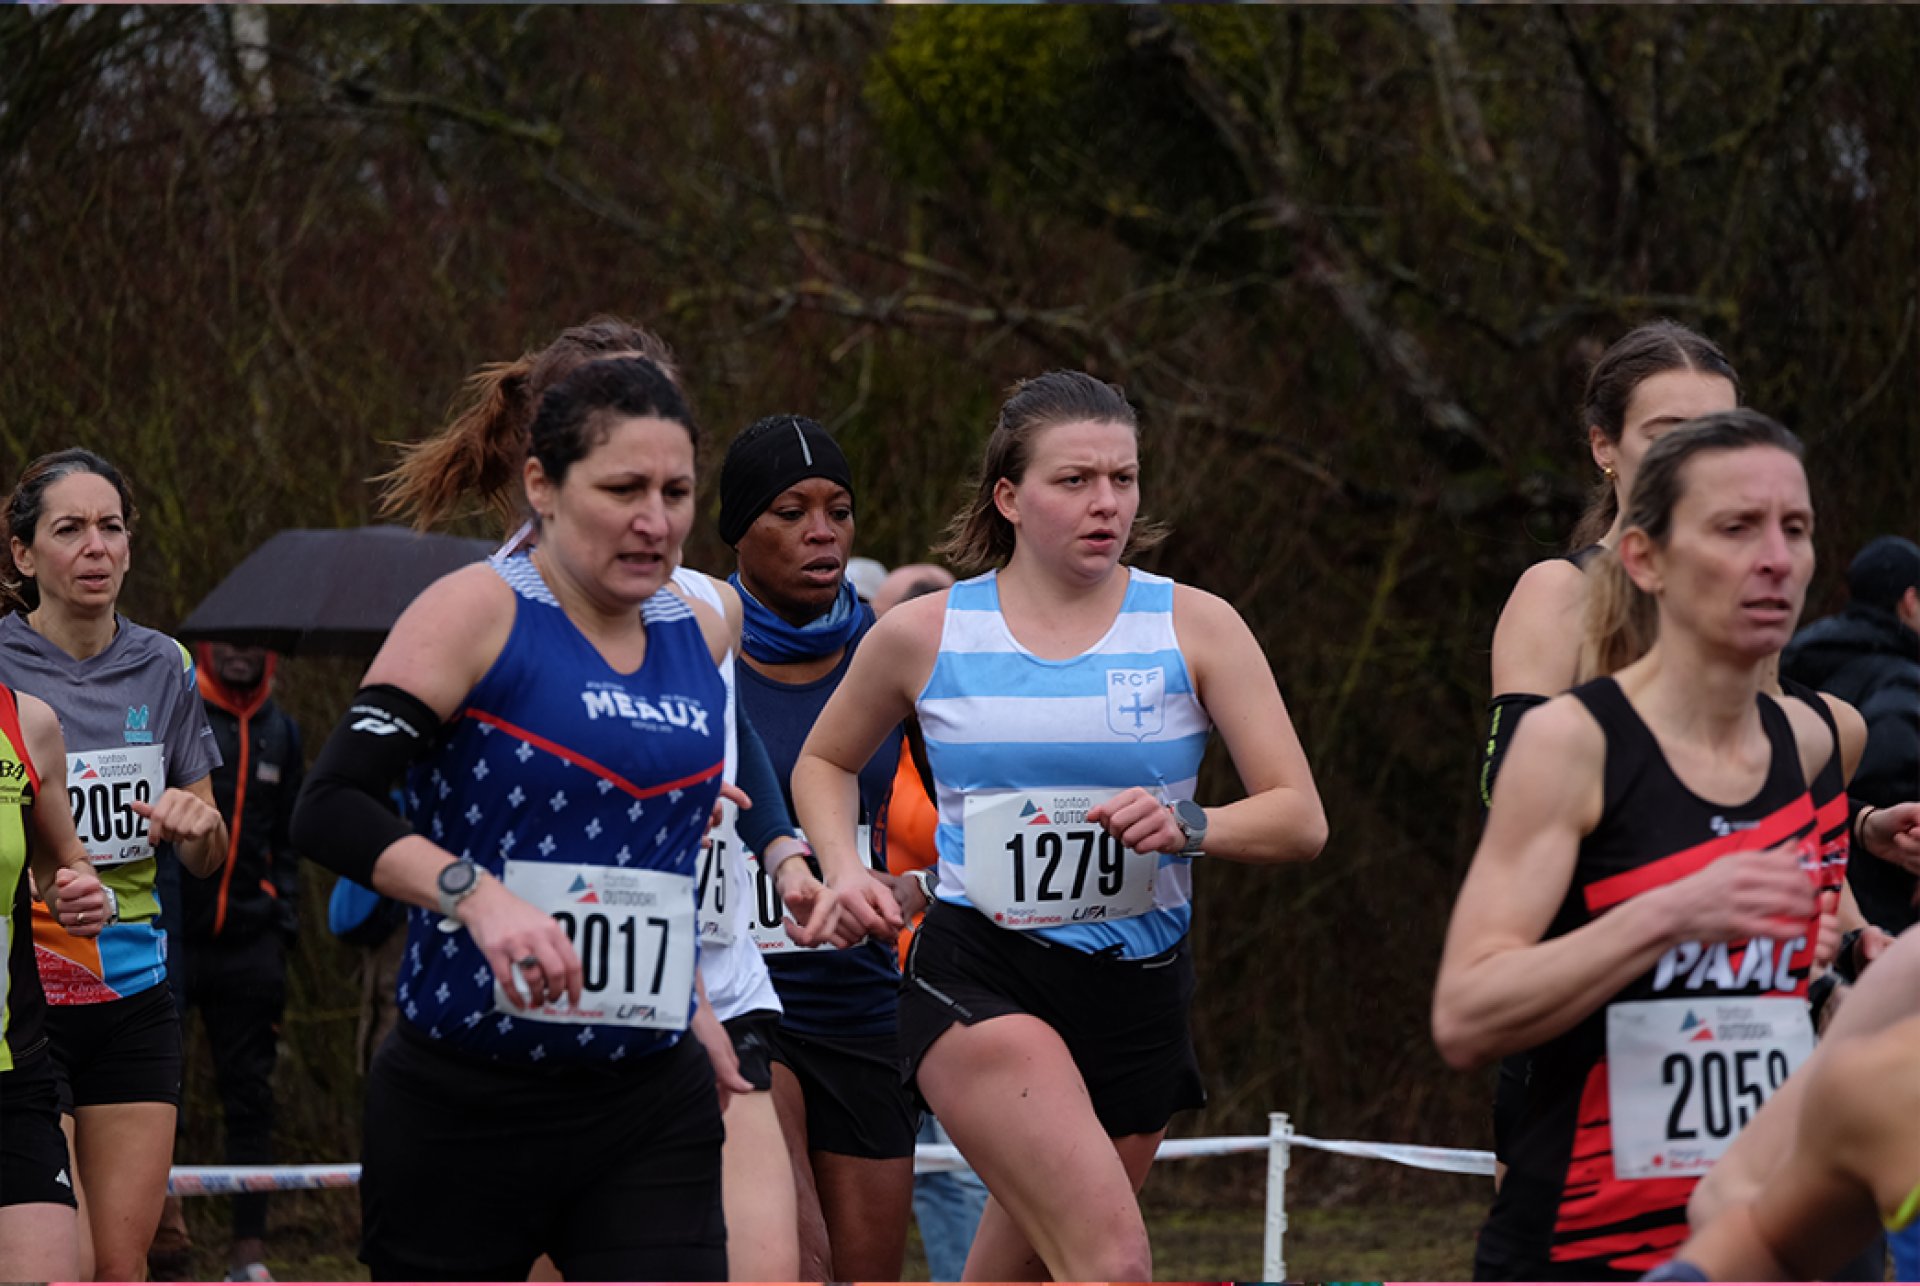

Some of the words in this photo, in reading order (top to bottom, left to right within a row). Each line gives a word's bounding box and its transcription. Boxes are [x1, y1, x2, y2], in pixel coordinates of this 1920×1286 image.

[1111, 671, 1159, 687] RCF
[581, 690, 710, 737] MEAUX
[69, 779, 152, 843] 2052
[1053, 797, 1091, 809] tonton
[1005, 830, 1125, 903] 1279
[1653, 936, 1807, 991] PAAC
